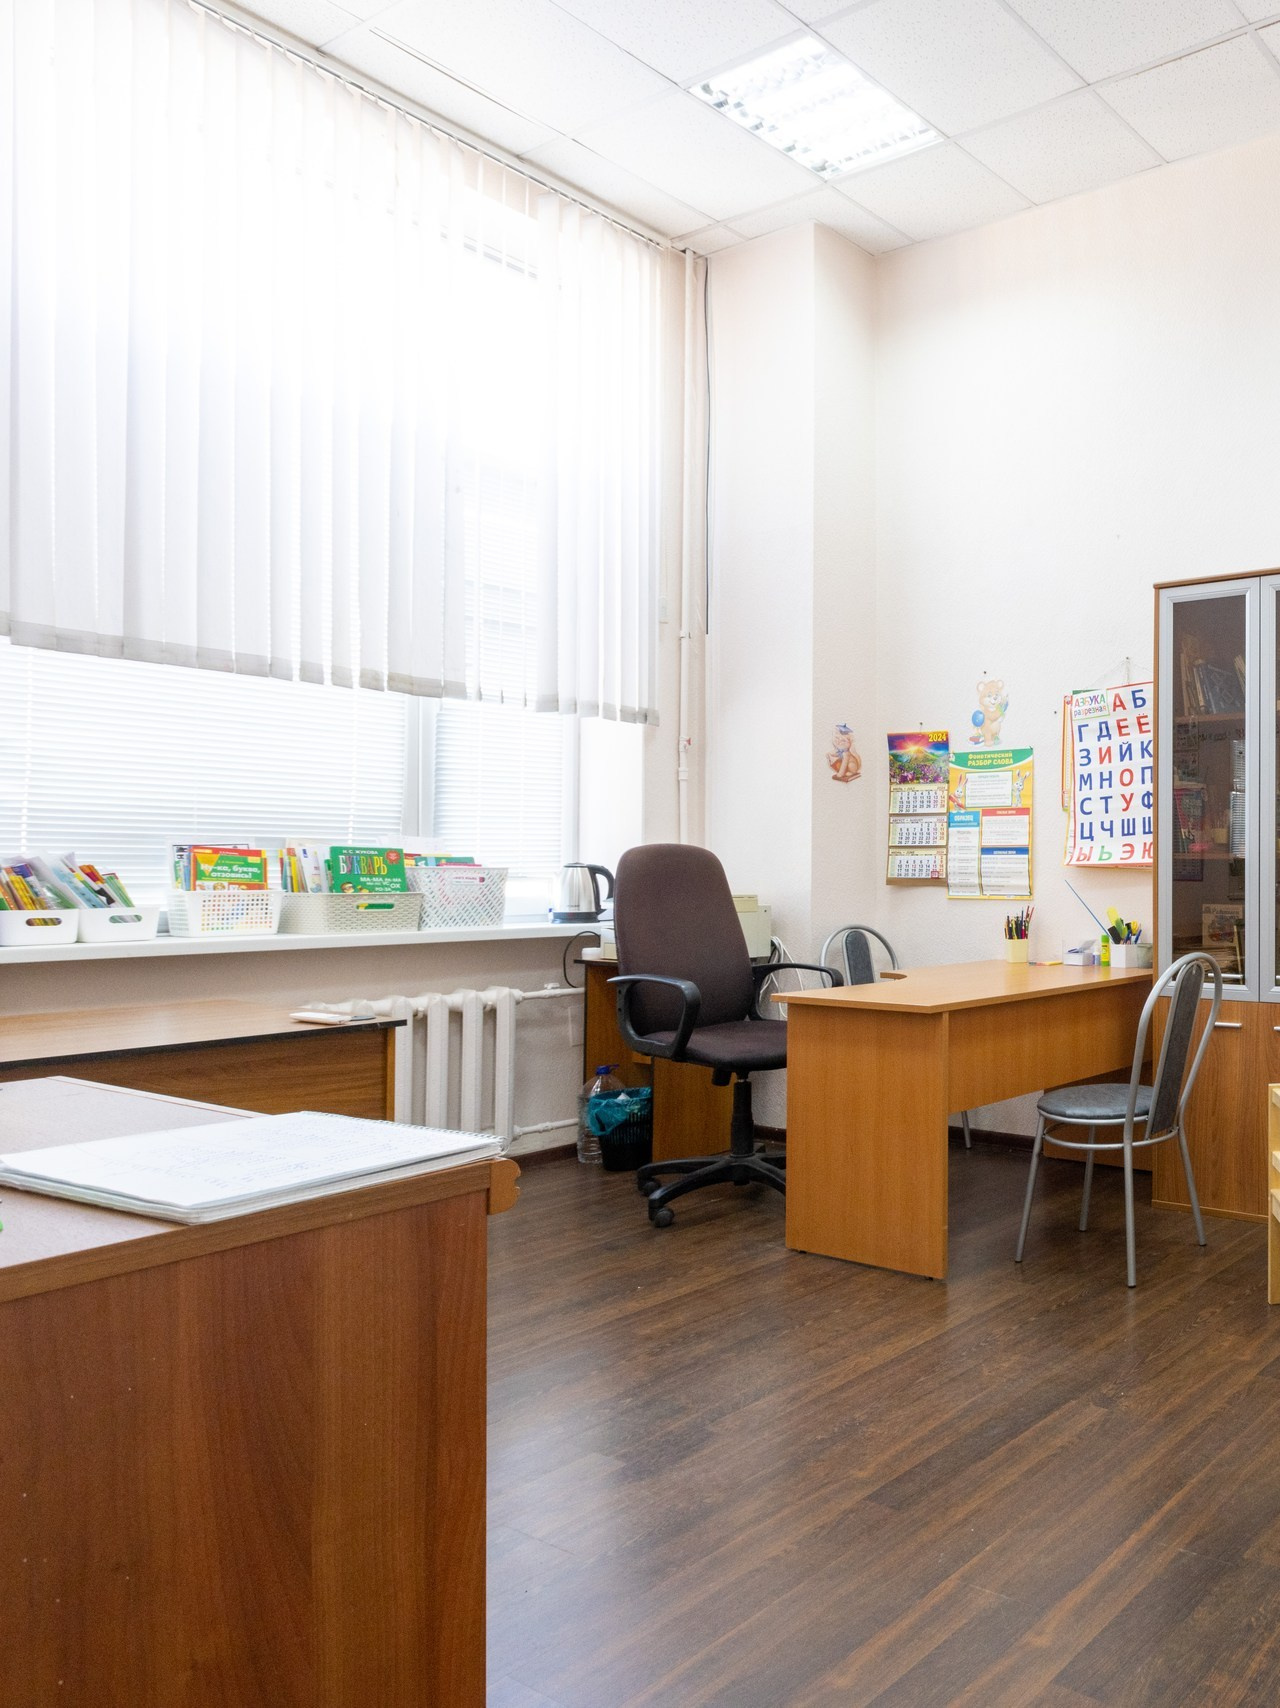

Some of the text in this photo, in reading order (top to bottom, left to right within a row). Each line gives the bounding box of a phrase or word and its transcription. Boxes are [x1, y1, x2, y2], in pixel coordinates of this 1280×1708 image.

[1075, 694, 1105, 708] АЗБУКА
[1113, 689, 1146, 712] А Б
[1074, 705, 1107, 717] разрезная
[928, 733, 947, 742] 2024
[1078, 713, 1151, 742] Г Д Е Ё
[1079, 740, 1153, 766] З И Й К
[1079, 766, 1153, 791] М Н О П
[1080, 797, 1092, 815] С
[1100, 796, 1113, 814] Т
[1120, 793, 1134, 812] У
[1080, 822, 1094, 841] Ц
[1100, 820, 1113, 838] Ч
[1122, 818, 1135, 836] Ш
[1076, 846, 1093, 862] Ы
[1098, 845, 1112, 861] Ь
[1120, 843, 1135, 860] Э
[201, 864, 260, 873] Ну-ка, буква,
[211, 871, 252, 879] отзовись!
[339, 855, 387, 875] БУКВАРЬ
